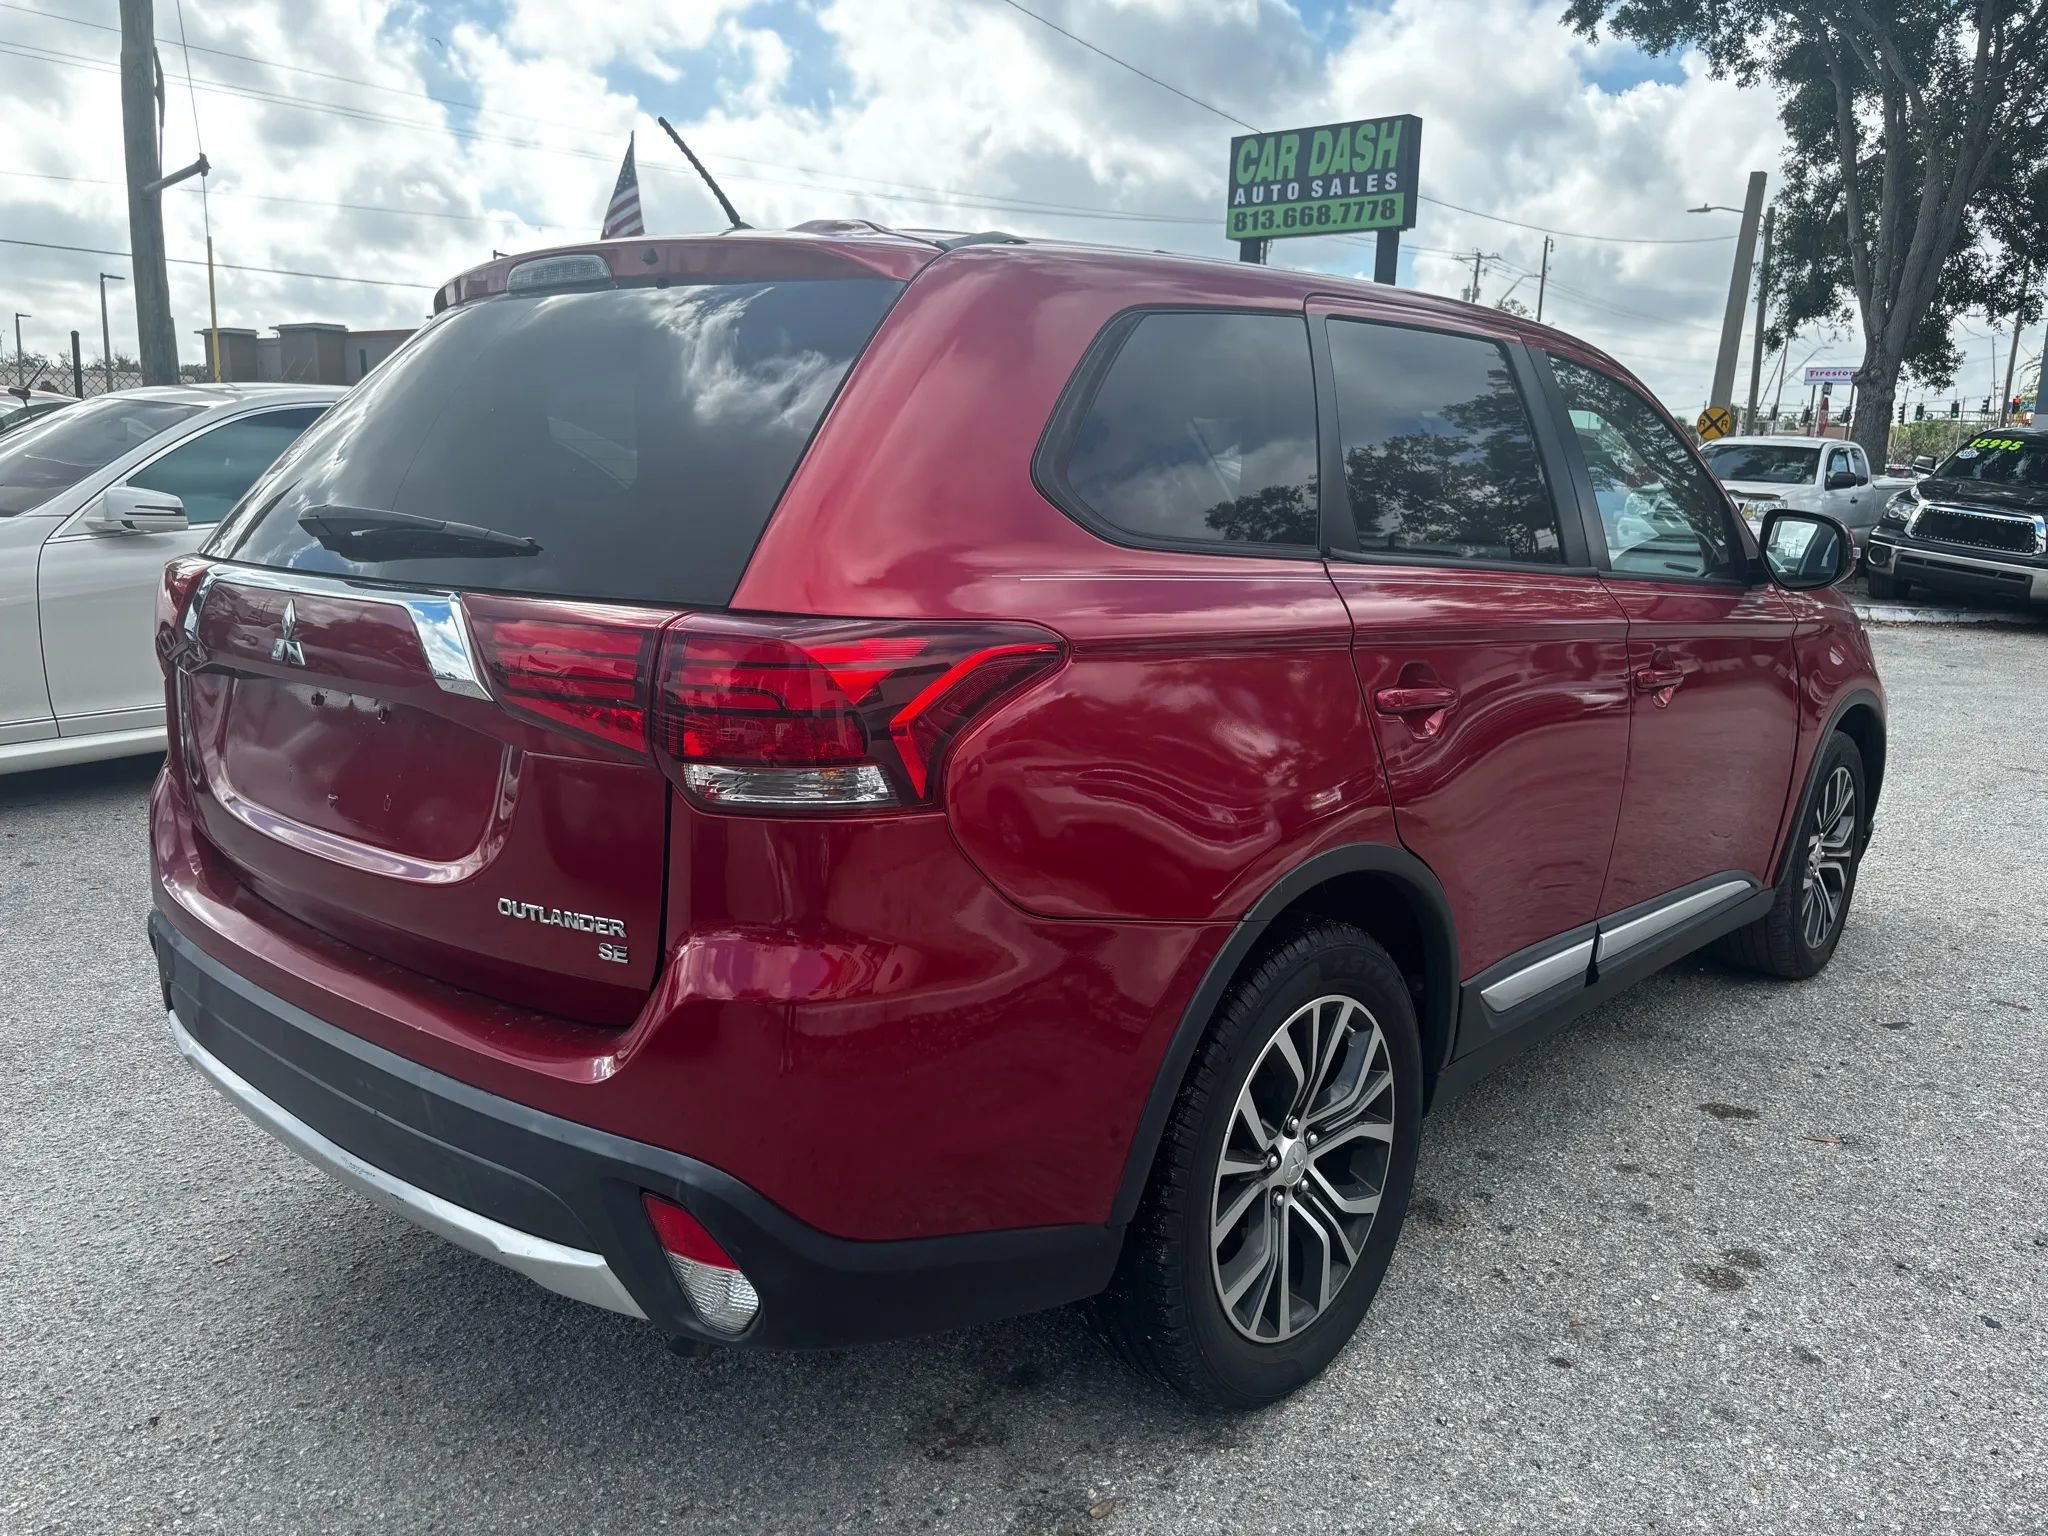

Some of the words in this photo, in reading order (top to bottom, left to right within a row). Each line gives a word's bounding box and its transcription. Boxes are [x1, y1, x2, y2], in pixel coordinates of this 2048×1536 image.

[1236, 134, 1299, 185] CAR
[1308, 120, 1402, 177] DASH
[1234, 182, 1299, 206] AUTO
[1311, 172, 1397, 198] SALES
[1233, 199, 1396, 232] 813.668.7778
[1969, 438, 2025, 451] 15995
[497, 897, 627, 938] OUTLANDER
[598, 943, 628, 964] SE
